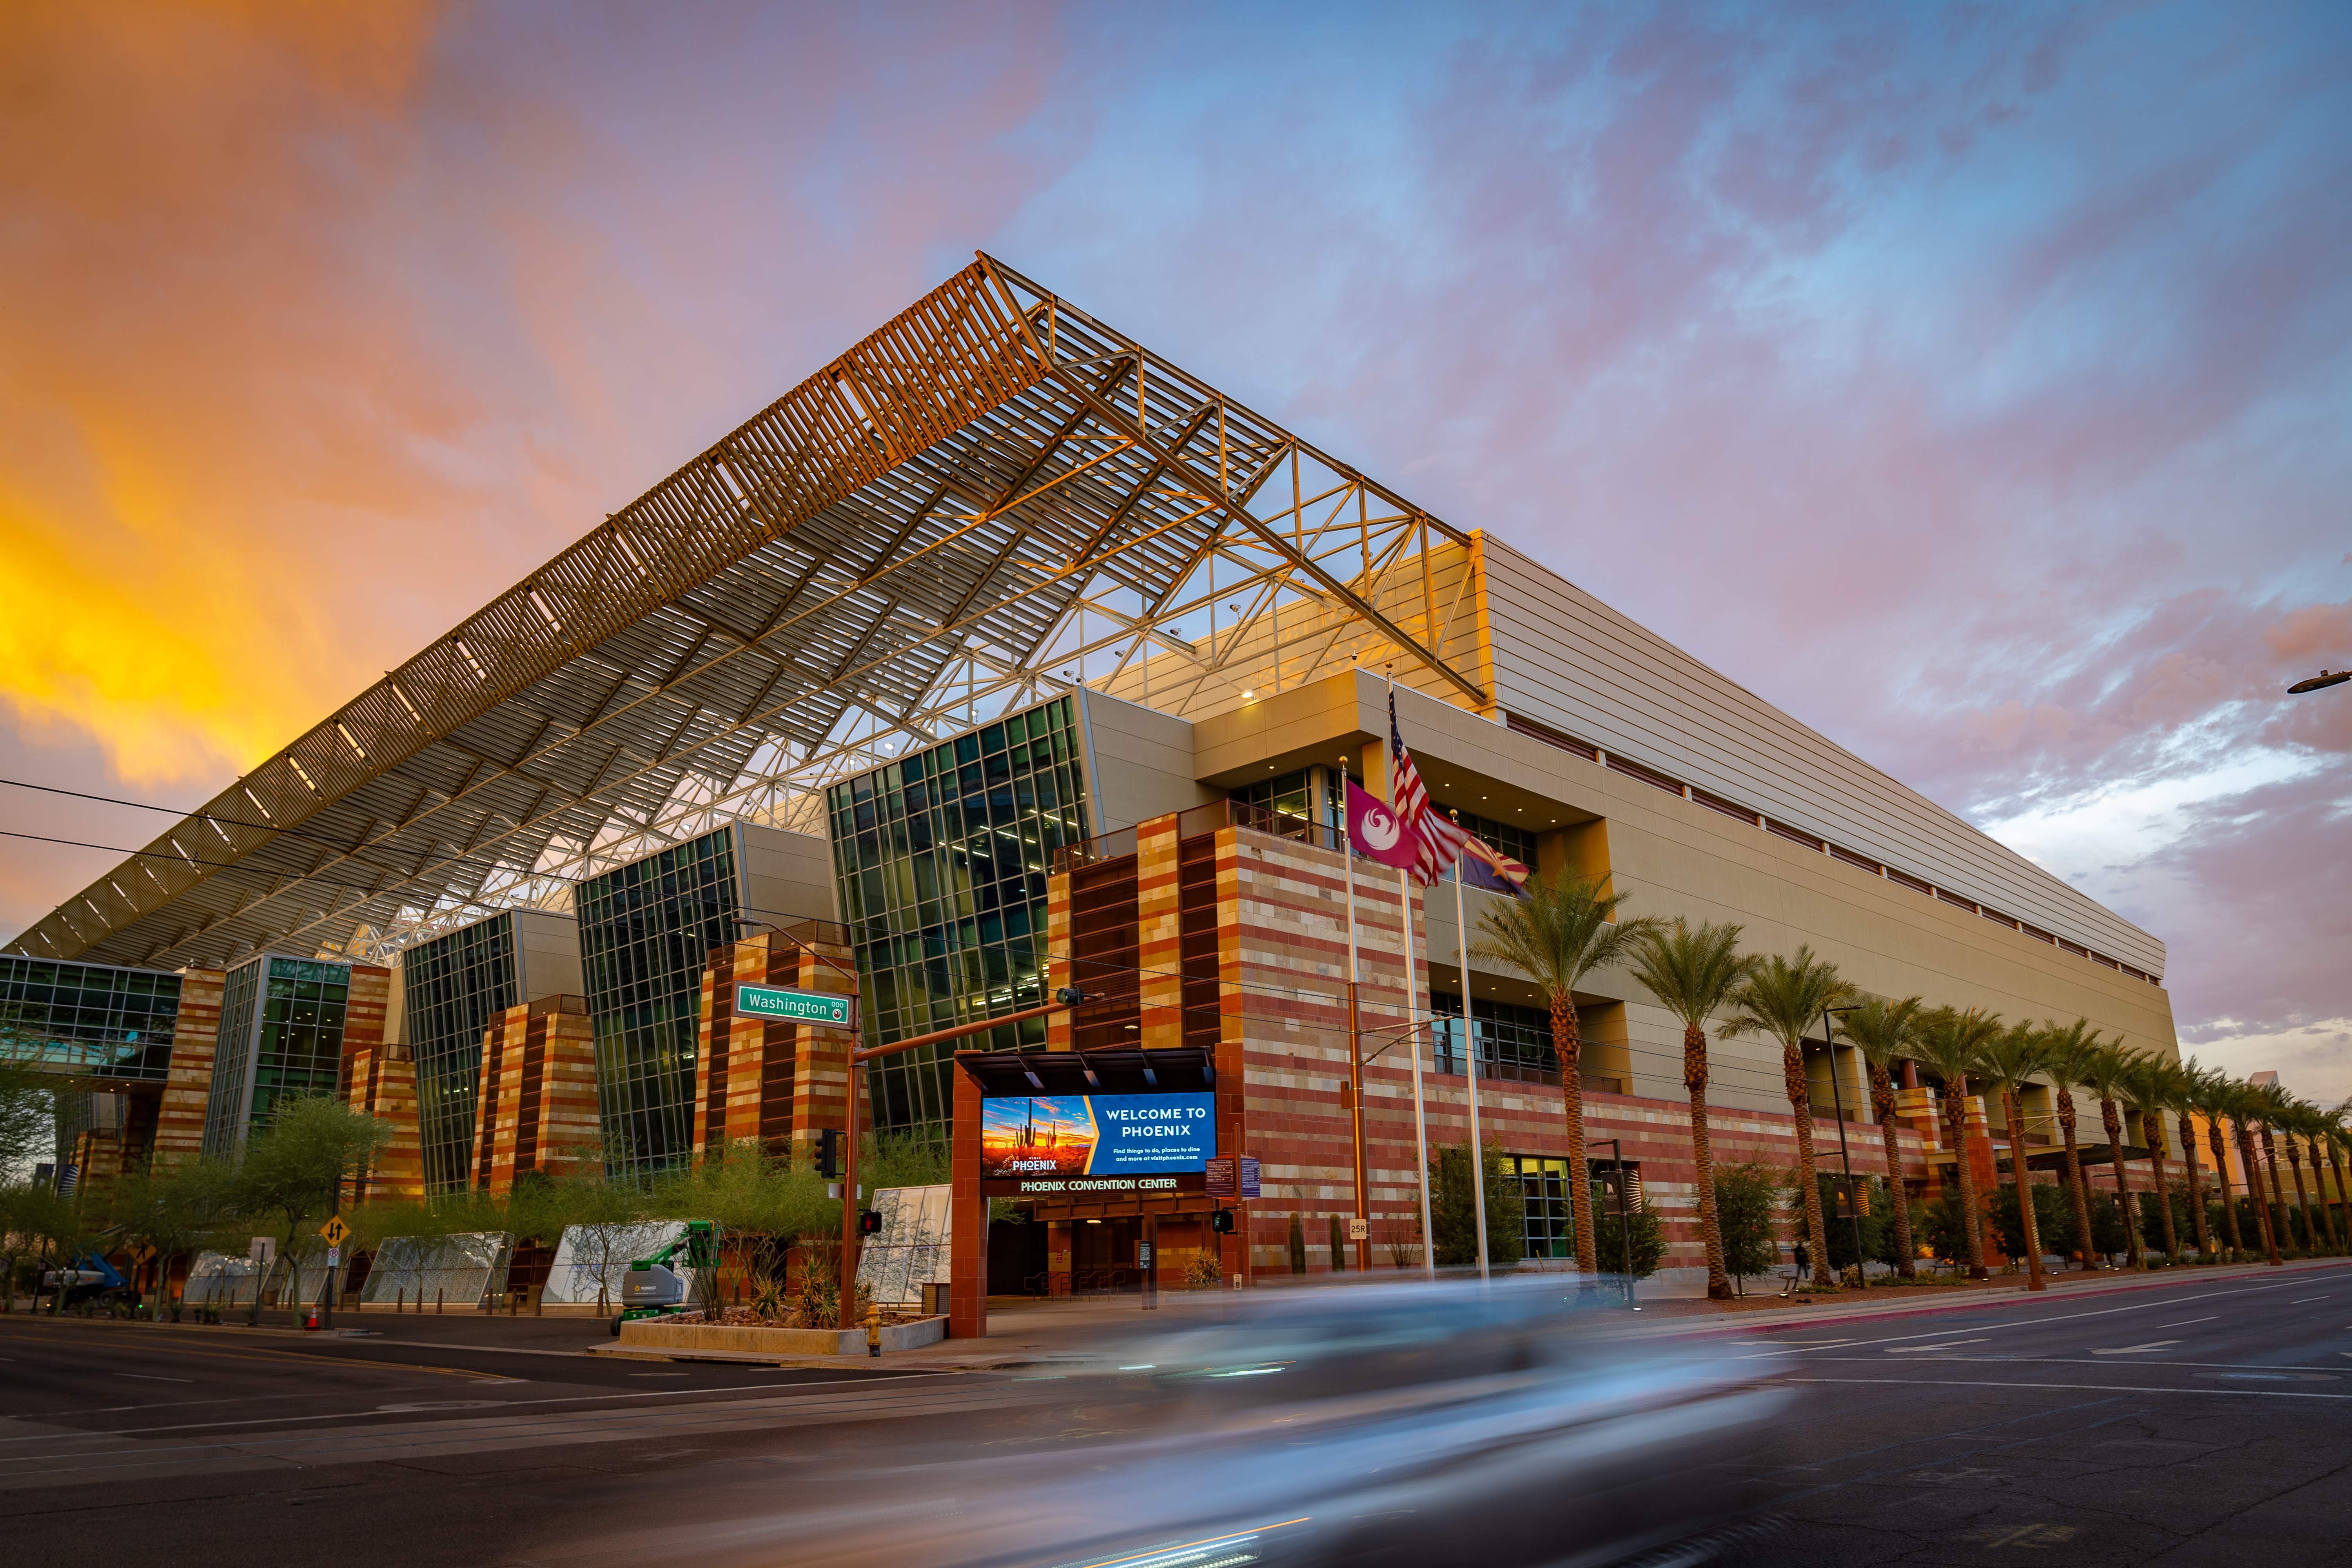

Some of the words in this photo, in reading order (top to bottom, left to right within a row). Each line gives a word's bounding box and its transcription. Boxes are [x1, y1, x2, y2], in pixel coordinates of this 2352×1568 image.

[750, 994, 827, 1015] Washington
[1106, 1108, 1181, 1120] WELCOME
[1186, 1108, 1206, 1118] TO
[1122, 1125, 1191, 1137] PHOENIX
[1013, 1160, 1057, 1171] PHOENIX
[1021, 1181, 1066, 1191] PHOENIX
[1069, 1180, 1135, 1190] CONVENTION
[1138, 1179, 1177, 1189] CENTER
